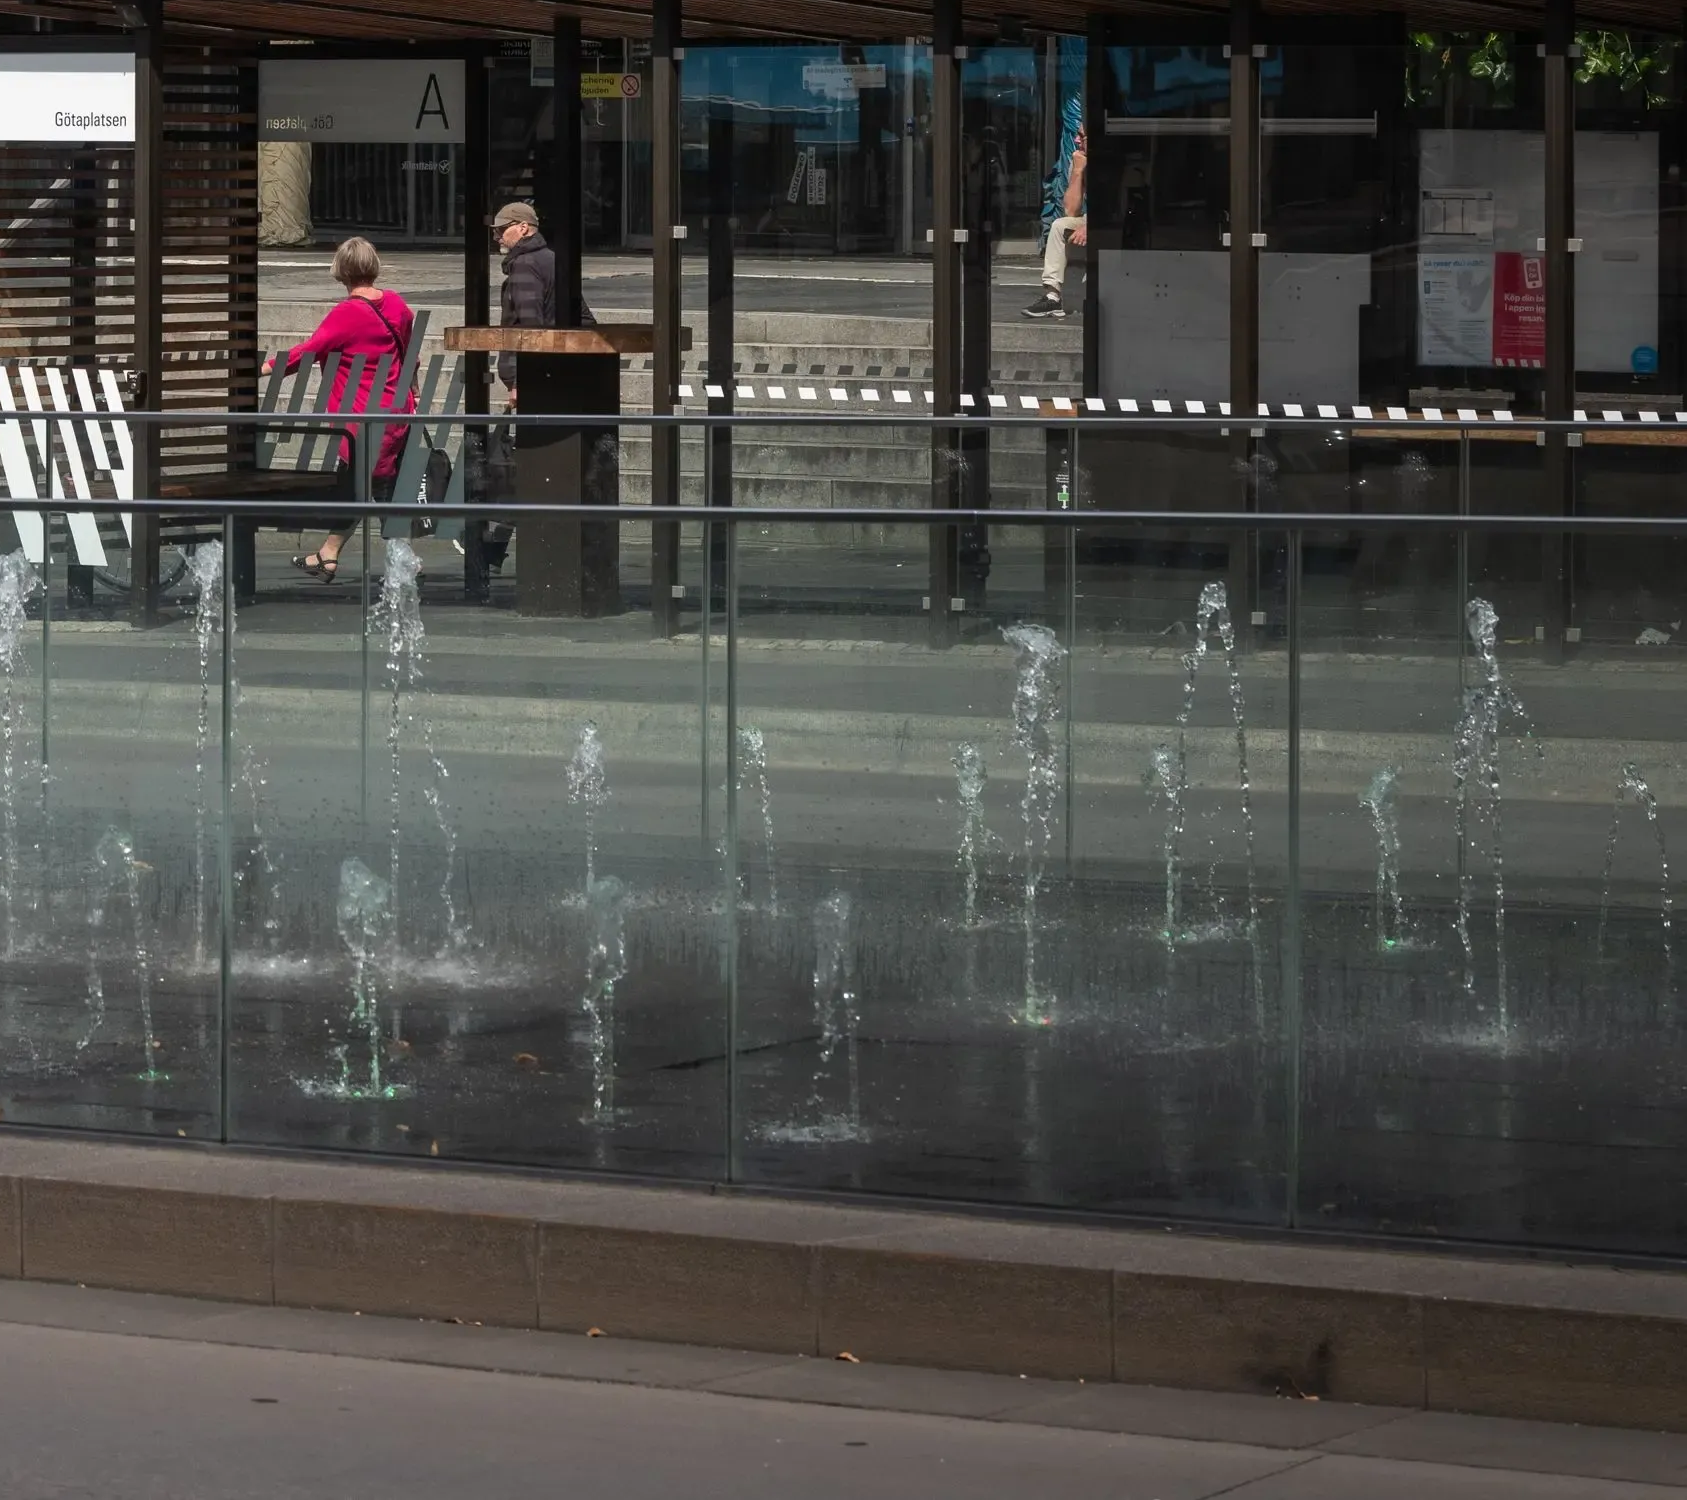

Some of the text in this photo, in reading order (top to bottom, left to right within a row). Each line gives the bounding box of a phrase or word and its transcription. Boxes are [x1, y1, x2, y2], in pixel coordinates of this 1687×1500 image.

[55, 111, 127, 130] Götaplatsen
[1504, 293, 1521, 303] Köp
[1521, 293, 1535, 302] din
[1508, 304, 1535, 313] appen
